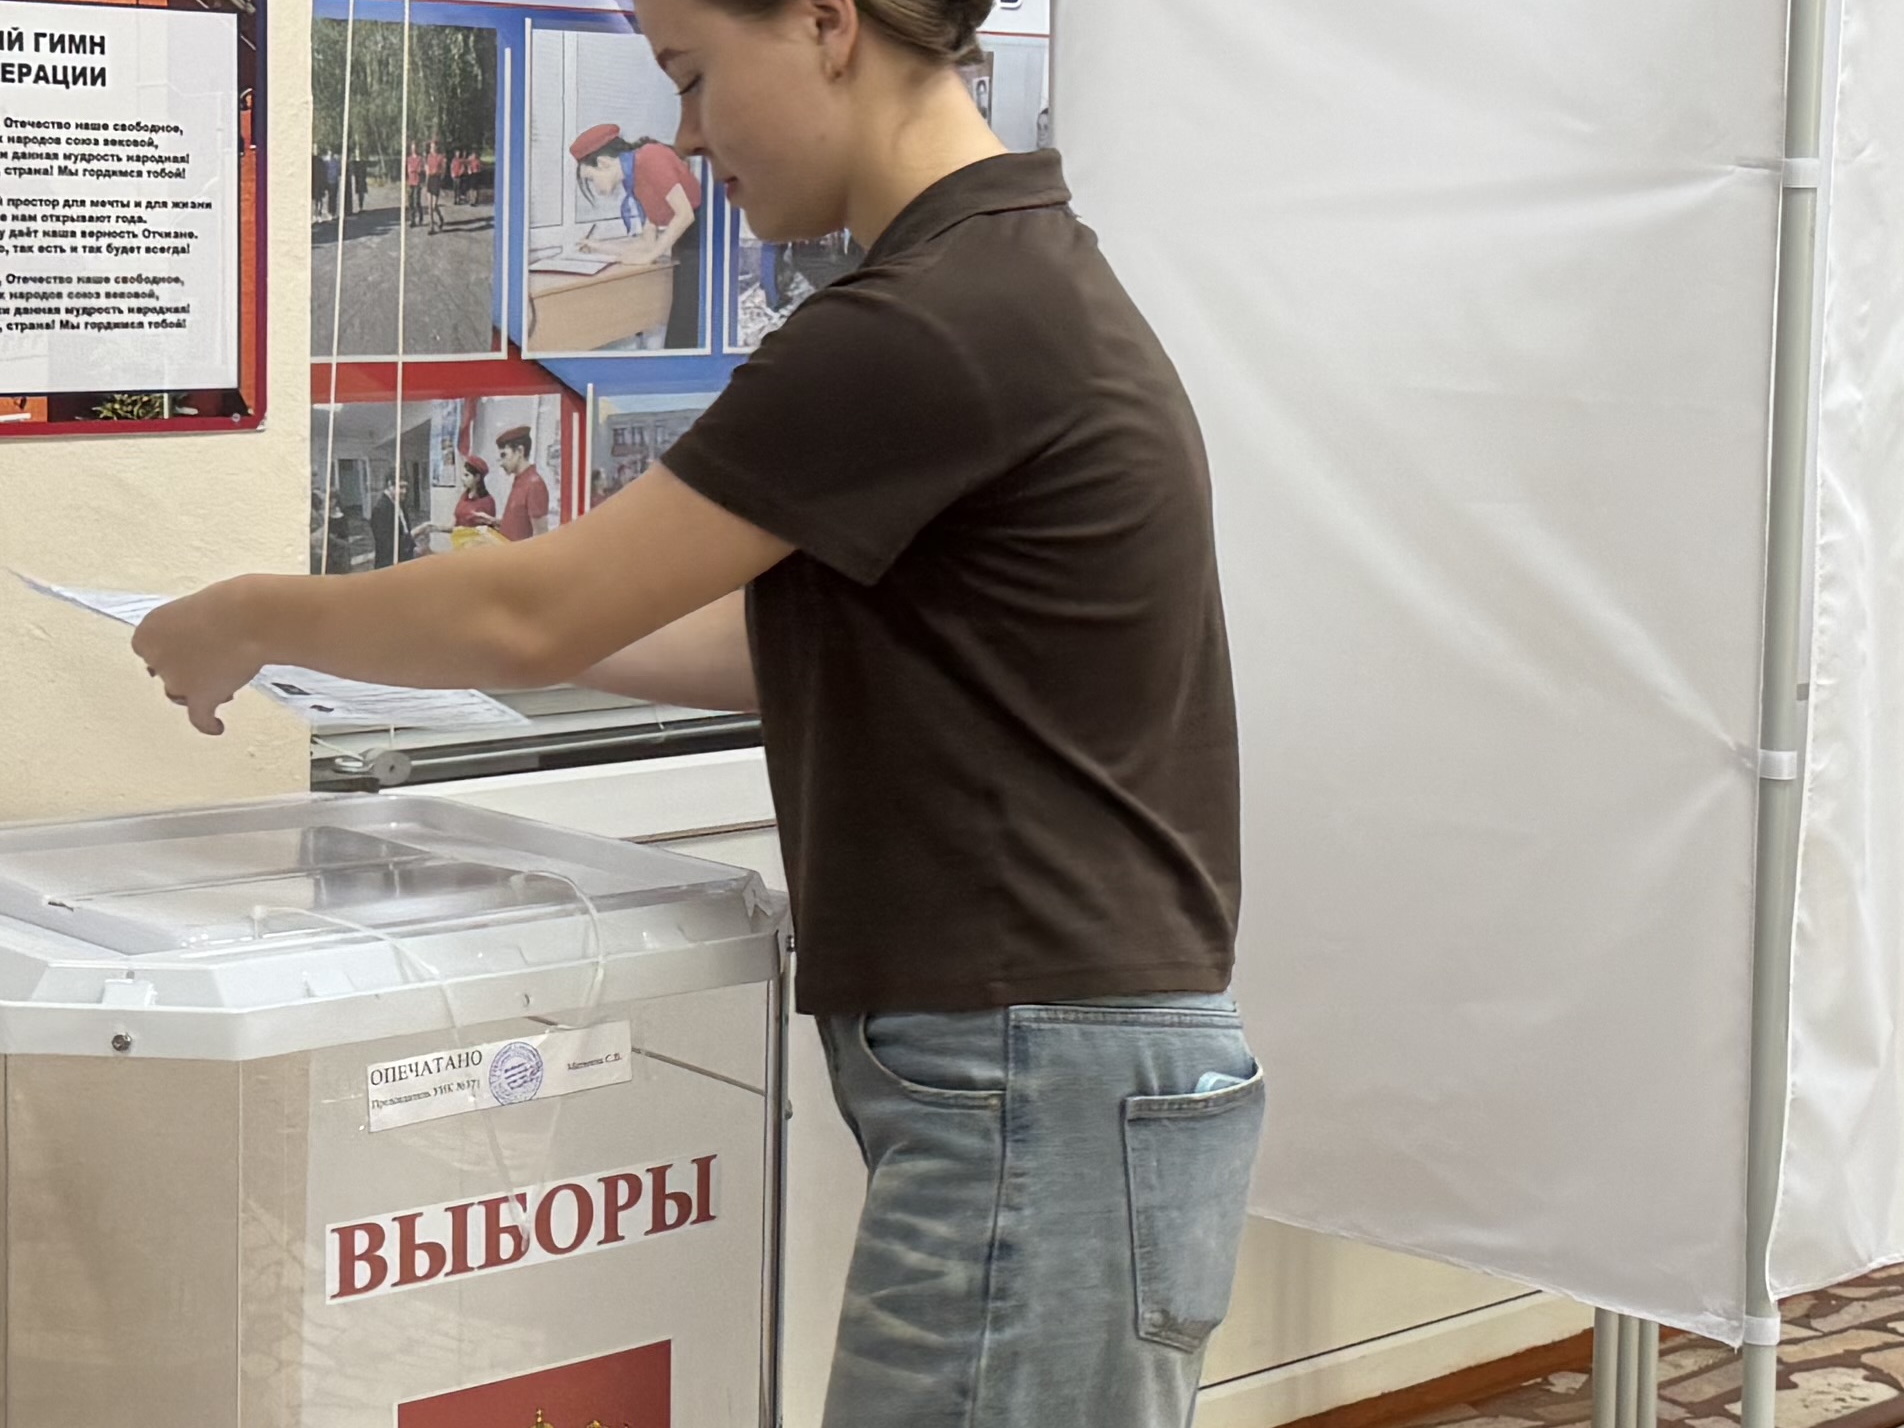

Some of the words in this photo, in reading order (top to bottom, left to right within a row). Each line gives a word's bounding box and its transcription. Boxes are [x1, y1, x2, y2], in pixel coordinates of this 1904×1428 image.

[33, 31, 106, 56] ГИМН
[3, 164, 54, 178] страна!
[56, 164, 79, 177] Мы
[81, 167, 143, 180] гордимся
[145, 166, 186, 179] тобой!
[11, 243, 34, 254] так
[36, 244, 67, 254] есть
[69, 244, 78, 254] и
[80, 244, 103, 254] так
[105, 241, 142, 257] будет
[144, 242, 190, 257] всегда!
[369, 1050, 483, 1086] ОПЕЧАТАНО
[330, 1154, 718, 1300] ВЫБОРЫ
